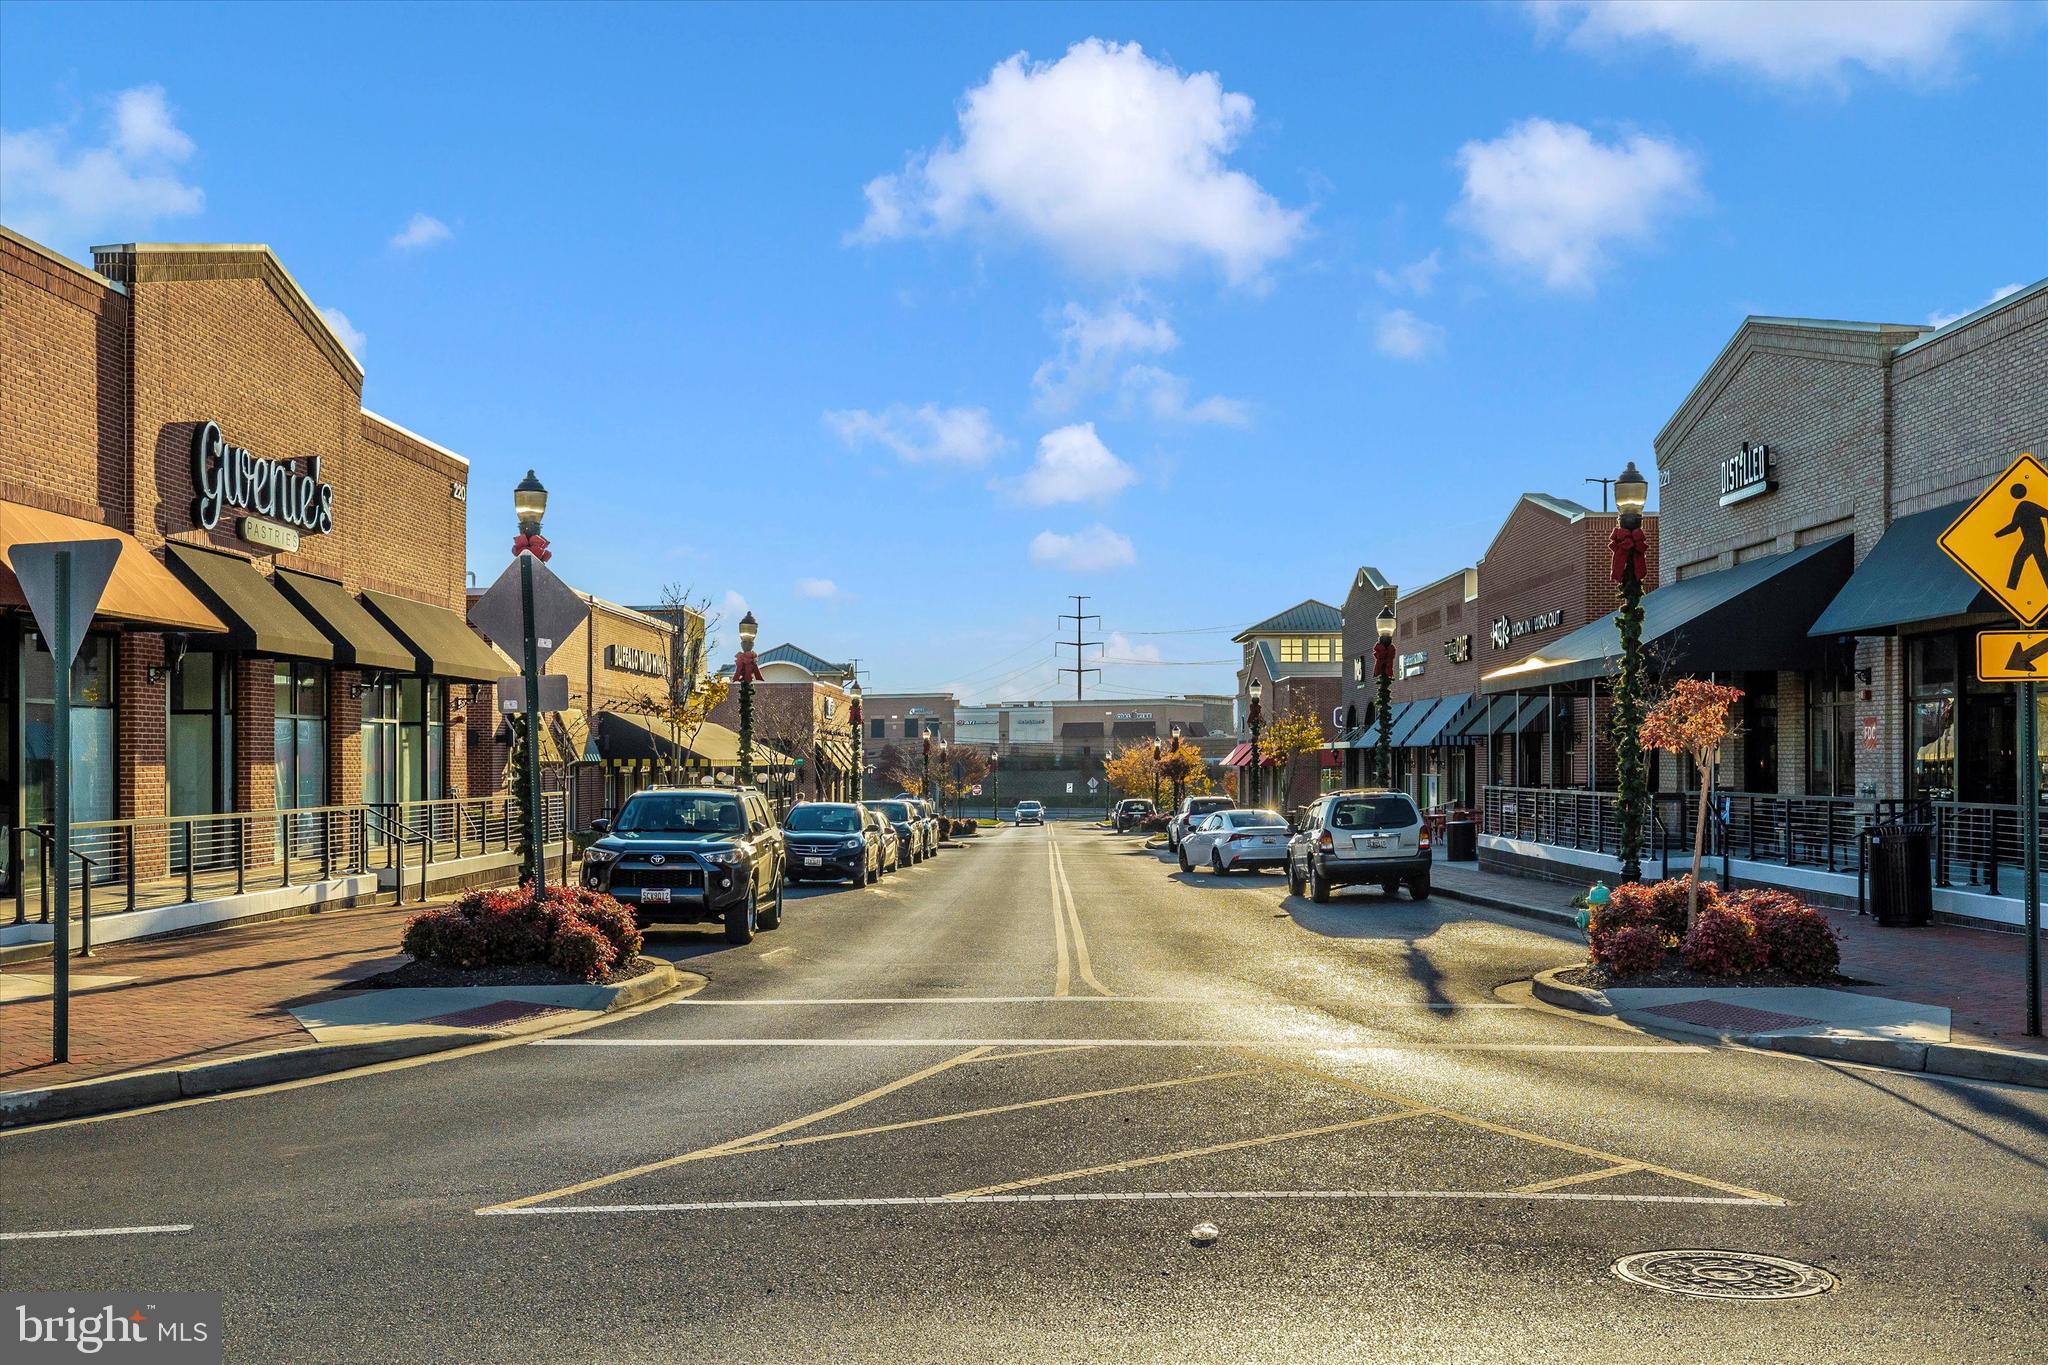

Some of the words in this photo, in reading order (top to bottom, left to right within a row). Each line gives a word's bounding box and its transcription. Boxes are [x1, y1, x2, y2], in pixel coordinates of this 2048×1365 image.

[200, 420, 333, 534] Gwenie's
[1721, 444, 1766, 494] DISTILLED
[453, 482, 466, 501] 220
[246, 521, 298, 548] PASTRIES
[1511, 621, 1525, 637] WOK
[1525, 619, 1531, 634] IN
[1533, 614, 1548, 631] WOK
[1548, 609, 1561, 628] OUT
[614, 644, 639, 670] BUFFALO
[1863, 726, 1876, 740] FDC
